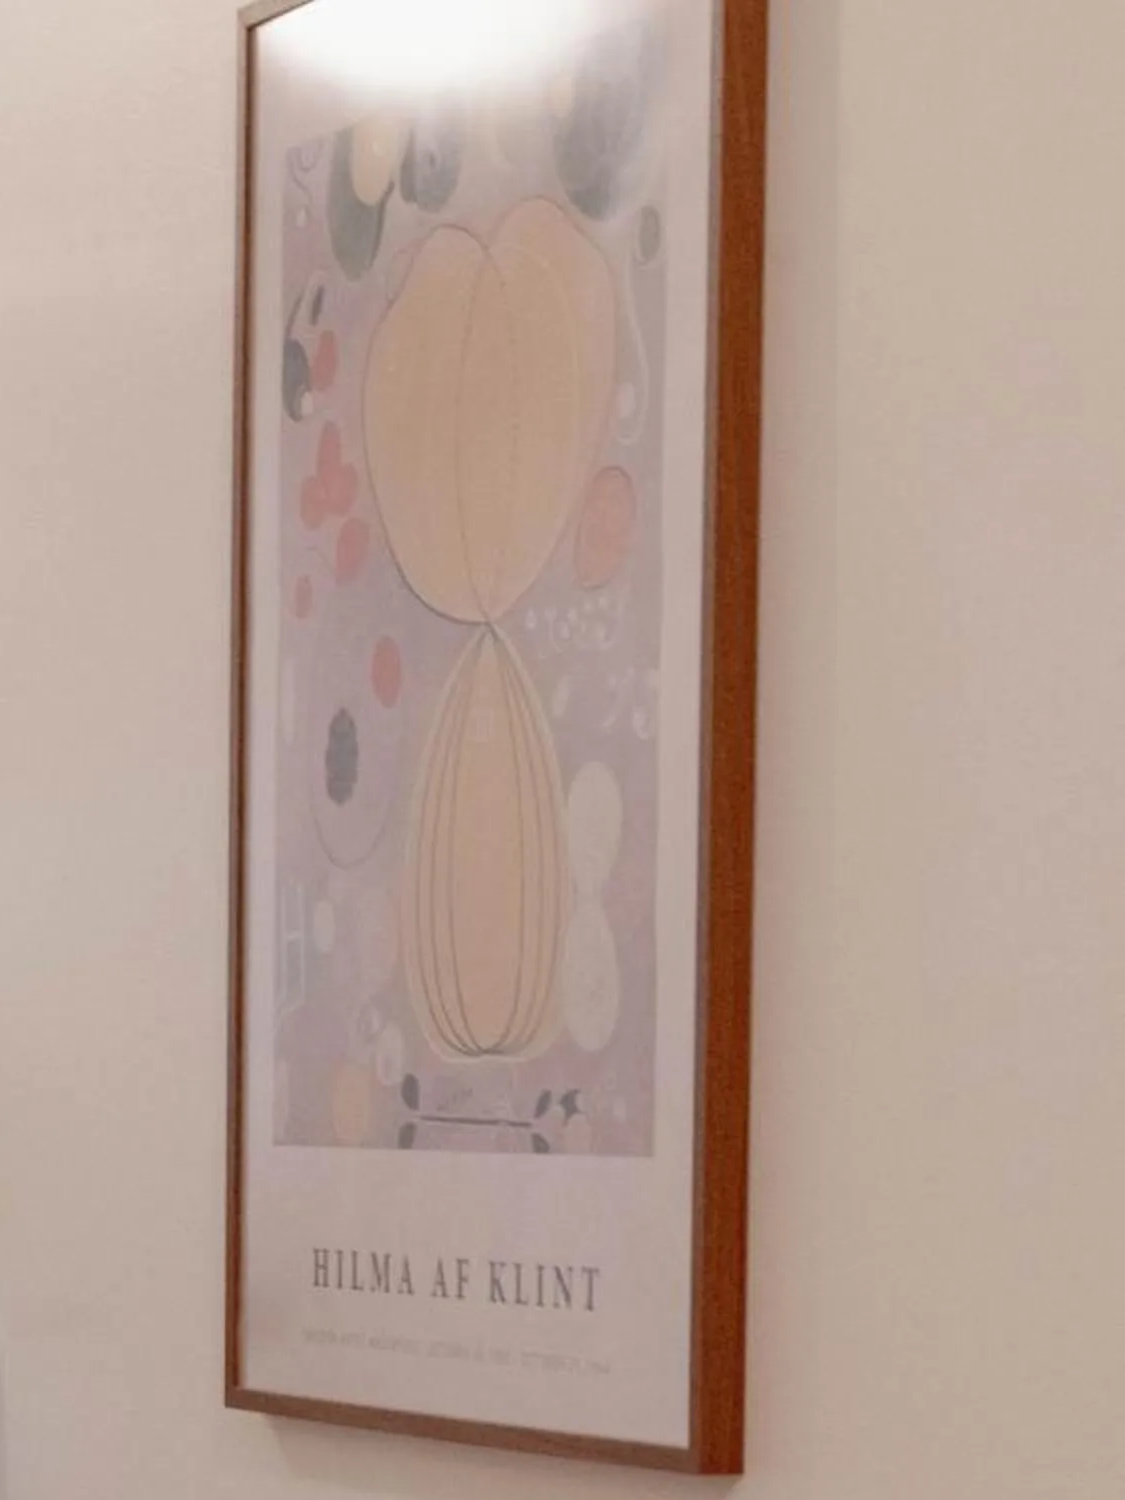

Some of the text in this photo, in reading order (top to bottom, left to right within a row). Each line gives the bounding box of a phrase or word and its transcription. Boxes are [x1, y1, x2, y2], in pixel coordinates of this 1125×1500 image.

[312, 1247, 601, 1312] HILMA AF KLINT
